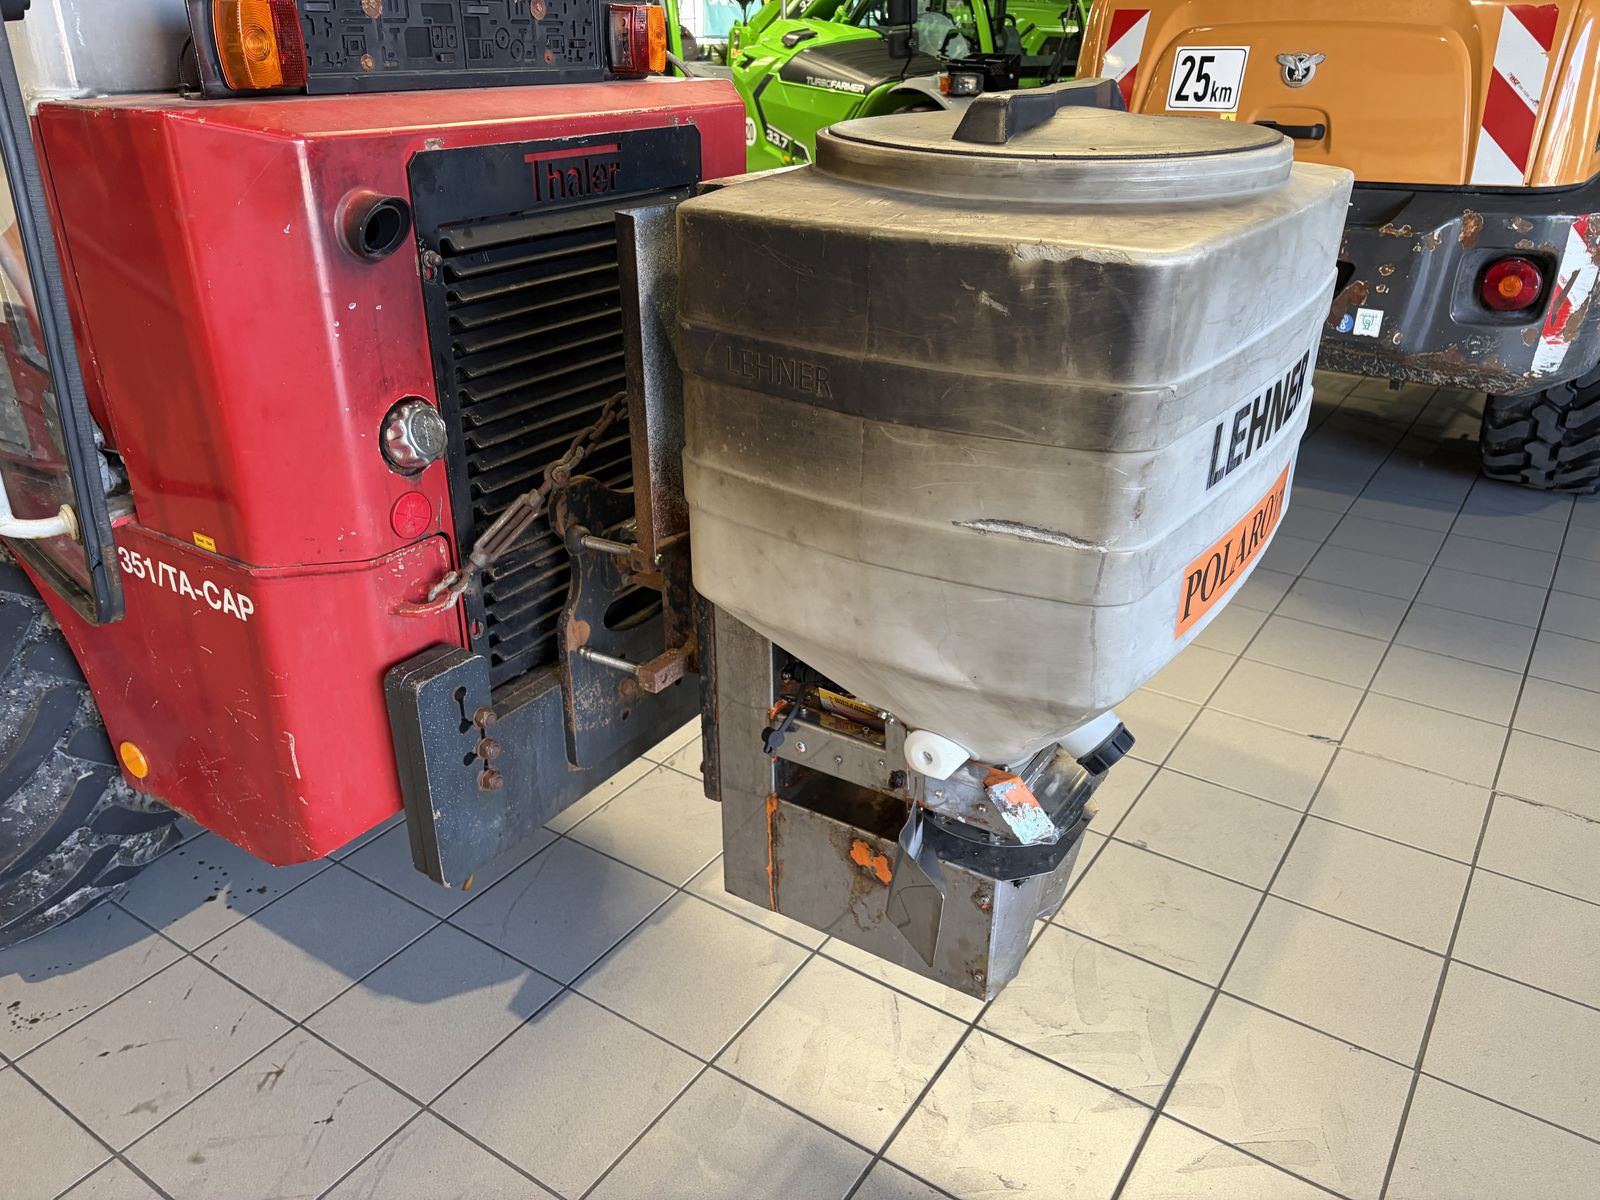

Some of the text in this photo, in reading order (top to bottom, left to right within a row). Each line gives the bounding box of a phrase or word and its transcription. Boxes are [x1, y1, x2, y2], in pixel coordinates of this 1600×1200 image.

[523, 143, 621, 202] Thaler
[727, 345, 834, 400] LEHNER
[1206, 348, 1310, 492] LEHNER
[117, 546, 255, 622] 351/TA-CAP
